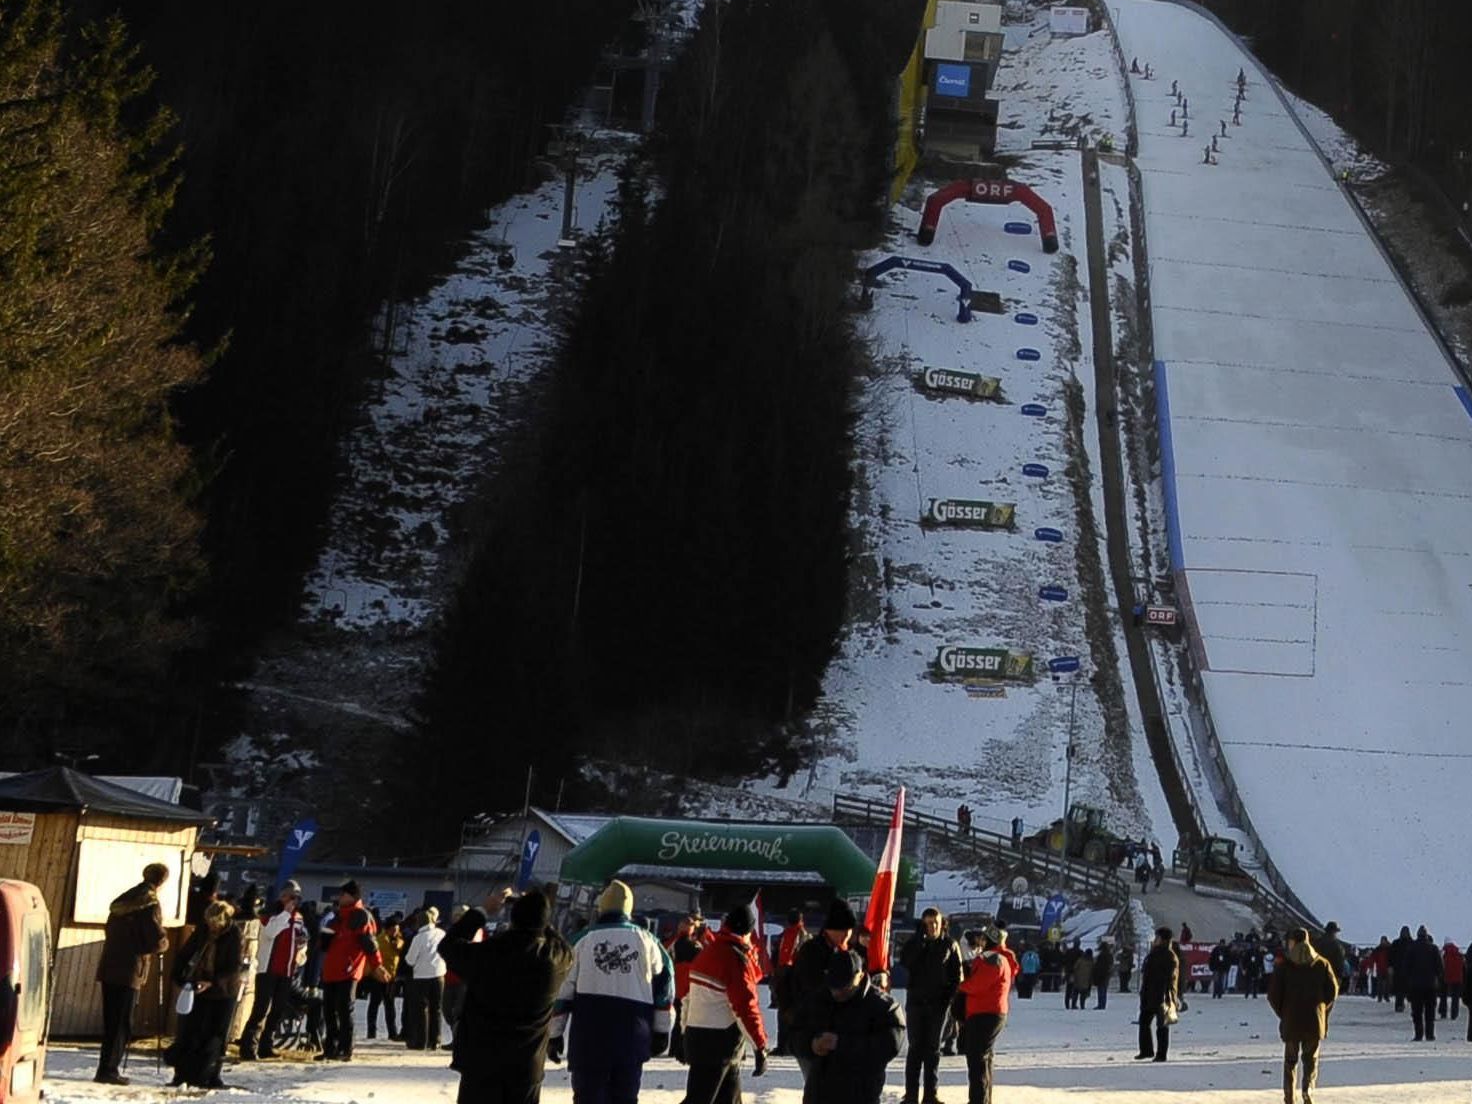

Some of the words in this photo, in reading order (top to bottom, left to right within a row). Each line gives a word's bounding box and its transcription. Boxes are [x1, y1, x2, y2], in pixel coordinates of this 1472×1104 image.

[975, 183, 1013, 196] ORF
[925, 368, 976, 390] Gösser
[932, 499, 987, 521] Gösser
[940, 647, 1001, 672] Gösser
[658, 831, 789, 865] Steiermark
